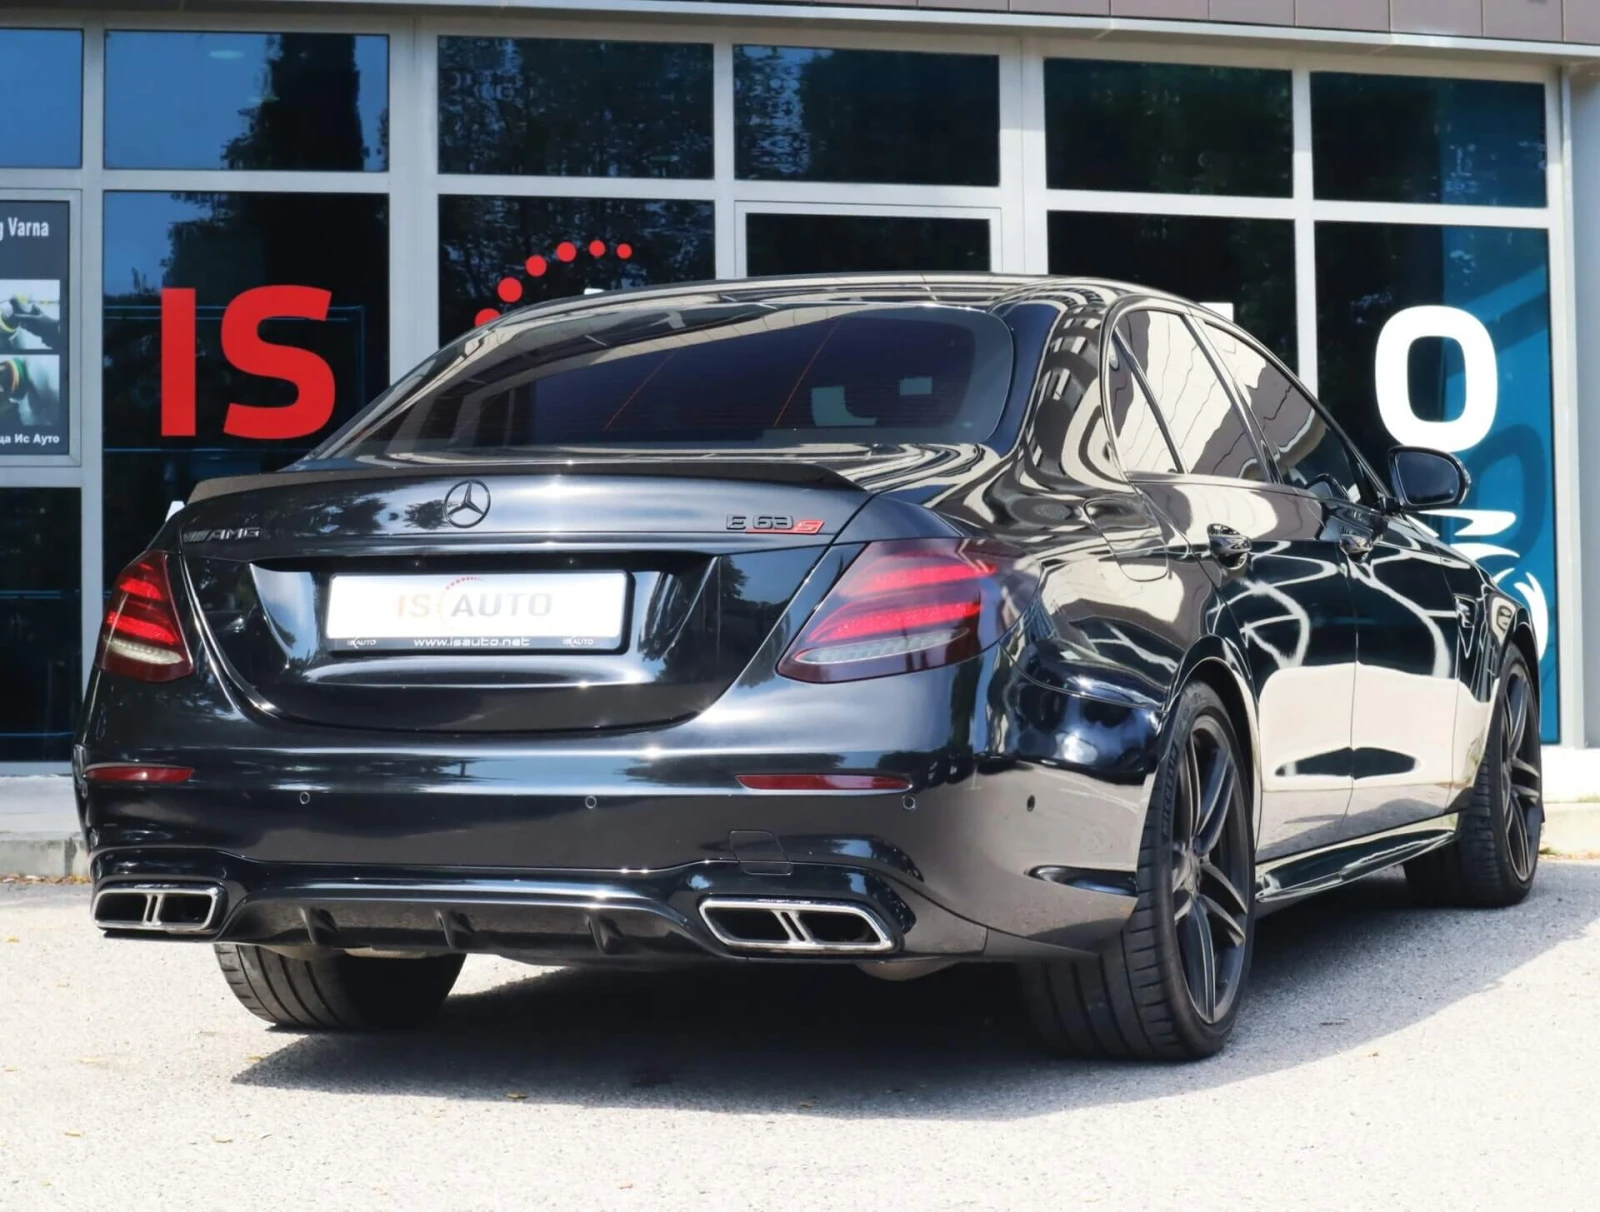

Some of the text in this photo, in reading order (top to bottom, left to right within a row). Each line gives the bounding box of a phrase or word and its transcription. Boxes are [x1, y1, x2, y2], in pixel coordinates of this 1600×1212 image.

[8, 216, 49, 237] Varna
[161, 285, 335, 440] IS
[14, 433, 30, 444] Ис
[33, 433, 60, 446] Ауто
[726, 514, 747, 530] E
[413, 637, 530, 647] www.isauto.net
